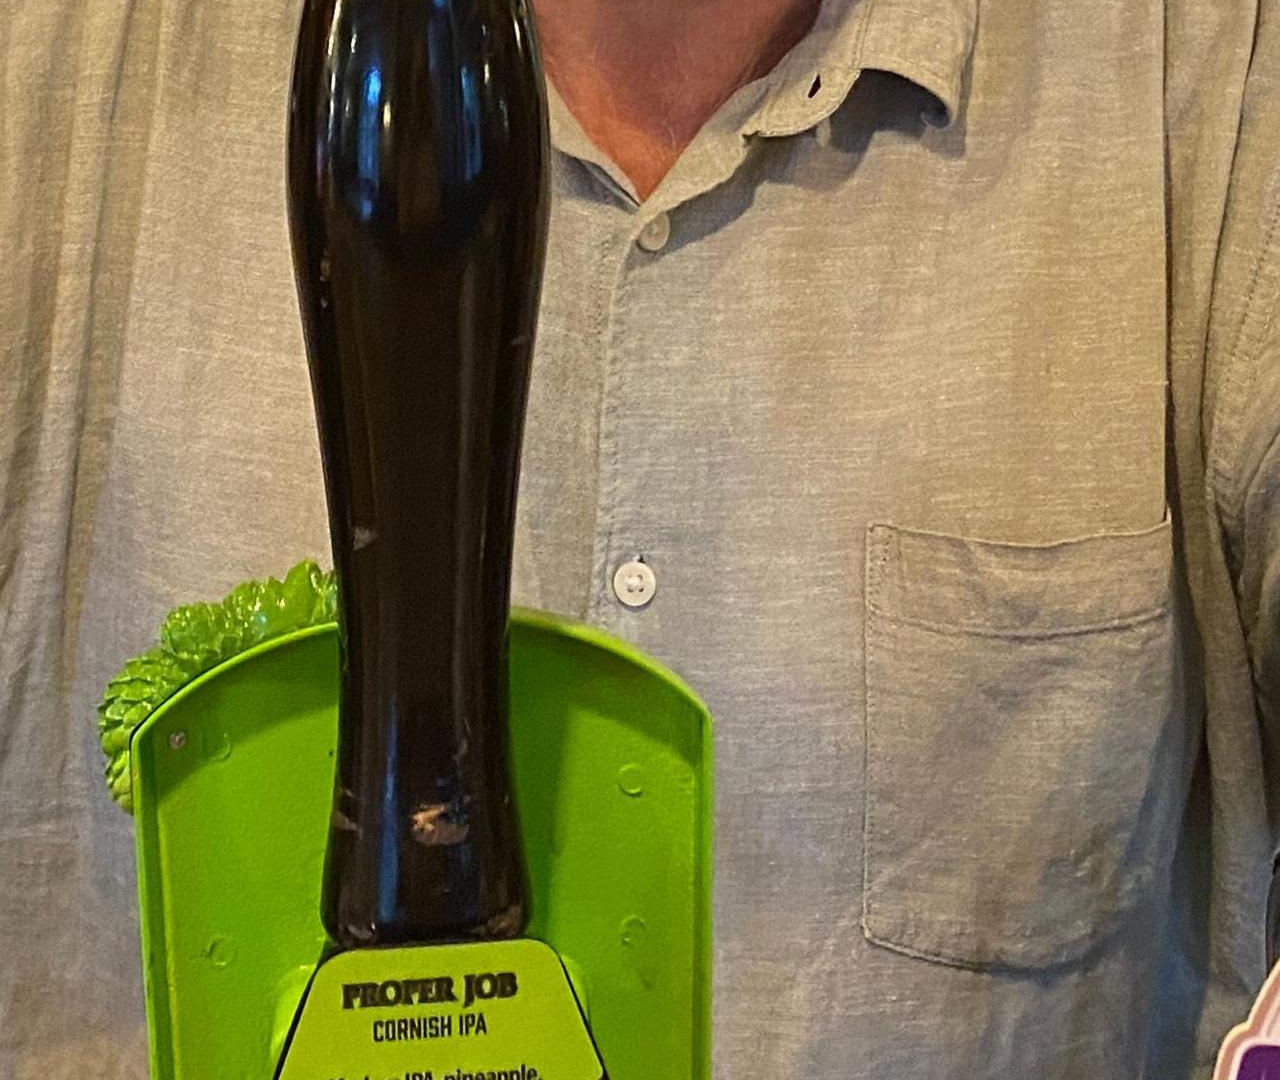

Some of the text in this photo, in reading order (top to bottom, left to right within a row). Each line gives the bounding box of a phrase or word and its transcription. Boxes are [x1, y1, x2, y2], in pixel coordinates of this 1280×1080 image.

[341, 970, 519, 1010] PROPER JOB
[372, 1012, 488, 1043] CORNISH IPA
